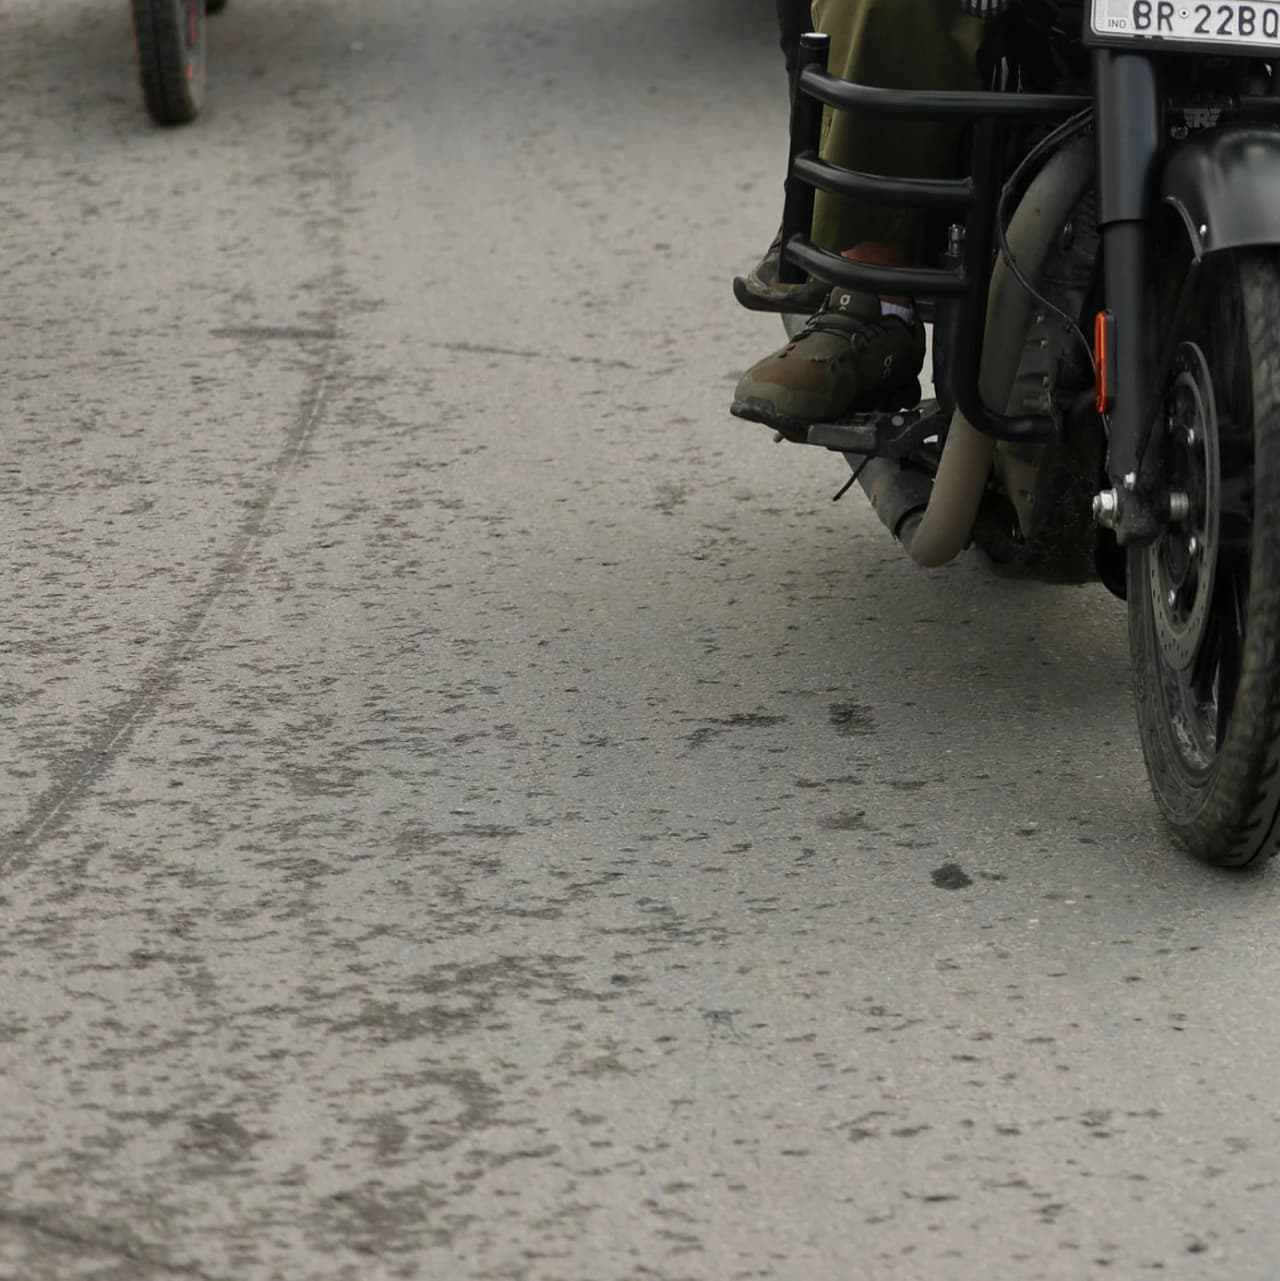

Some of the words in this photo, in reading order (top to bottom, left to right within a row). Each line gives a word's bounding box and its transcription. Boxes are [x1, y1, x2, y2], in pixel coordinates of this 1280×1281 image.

[1108, 19, 1126, 29] IND
[1133, 0, 1174, 32] BR
[1194, 4, 1279, 38] 22BQ
